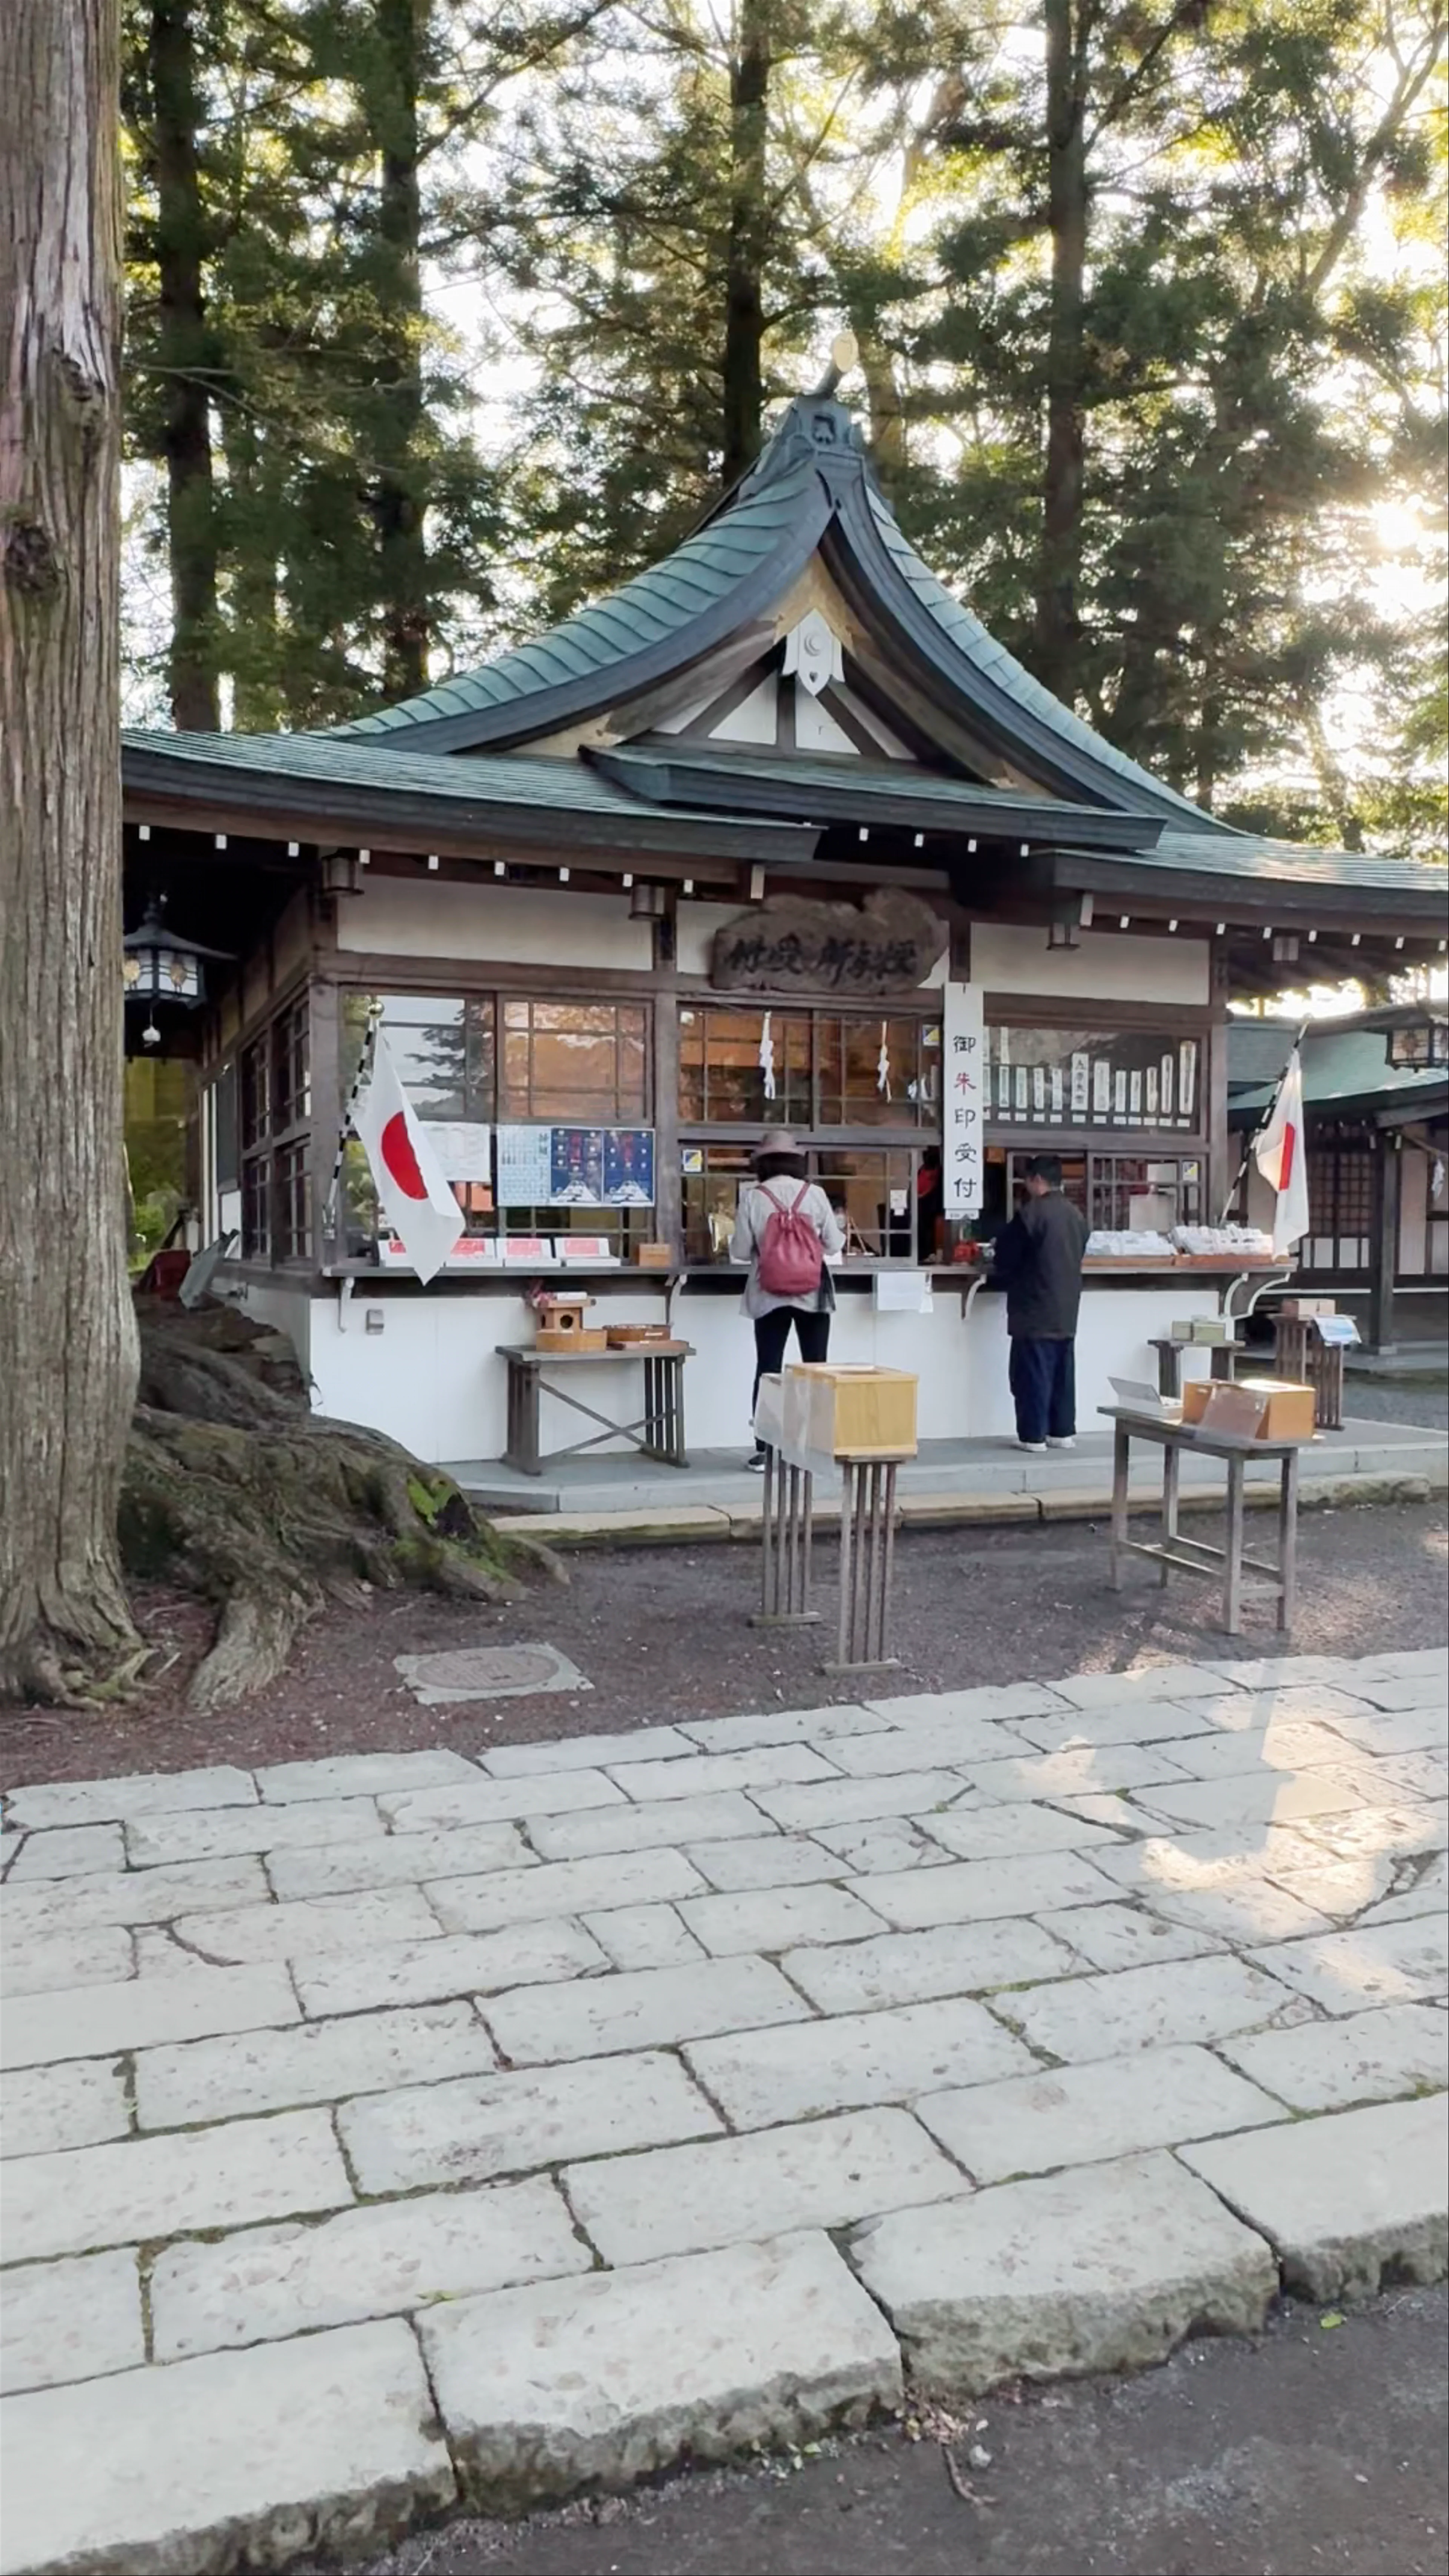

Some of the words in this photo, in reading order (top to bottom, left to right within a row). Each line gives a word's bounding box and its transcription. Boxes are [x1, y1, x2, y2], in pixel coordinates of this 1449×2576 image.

[953, 1035, 977, 1198] 御朱印受付
